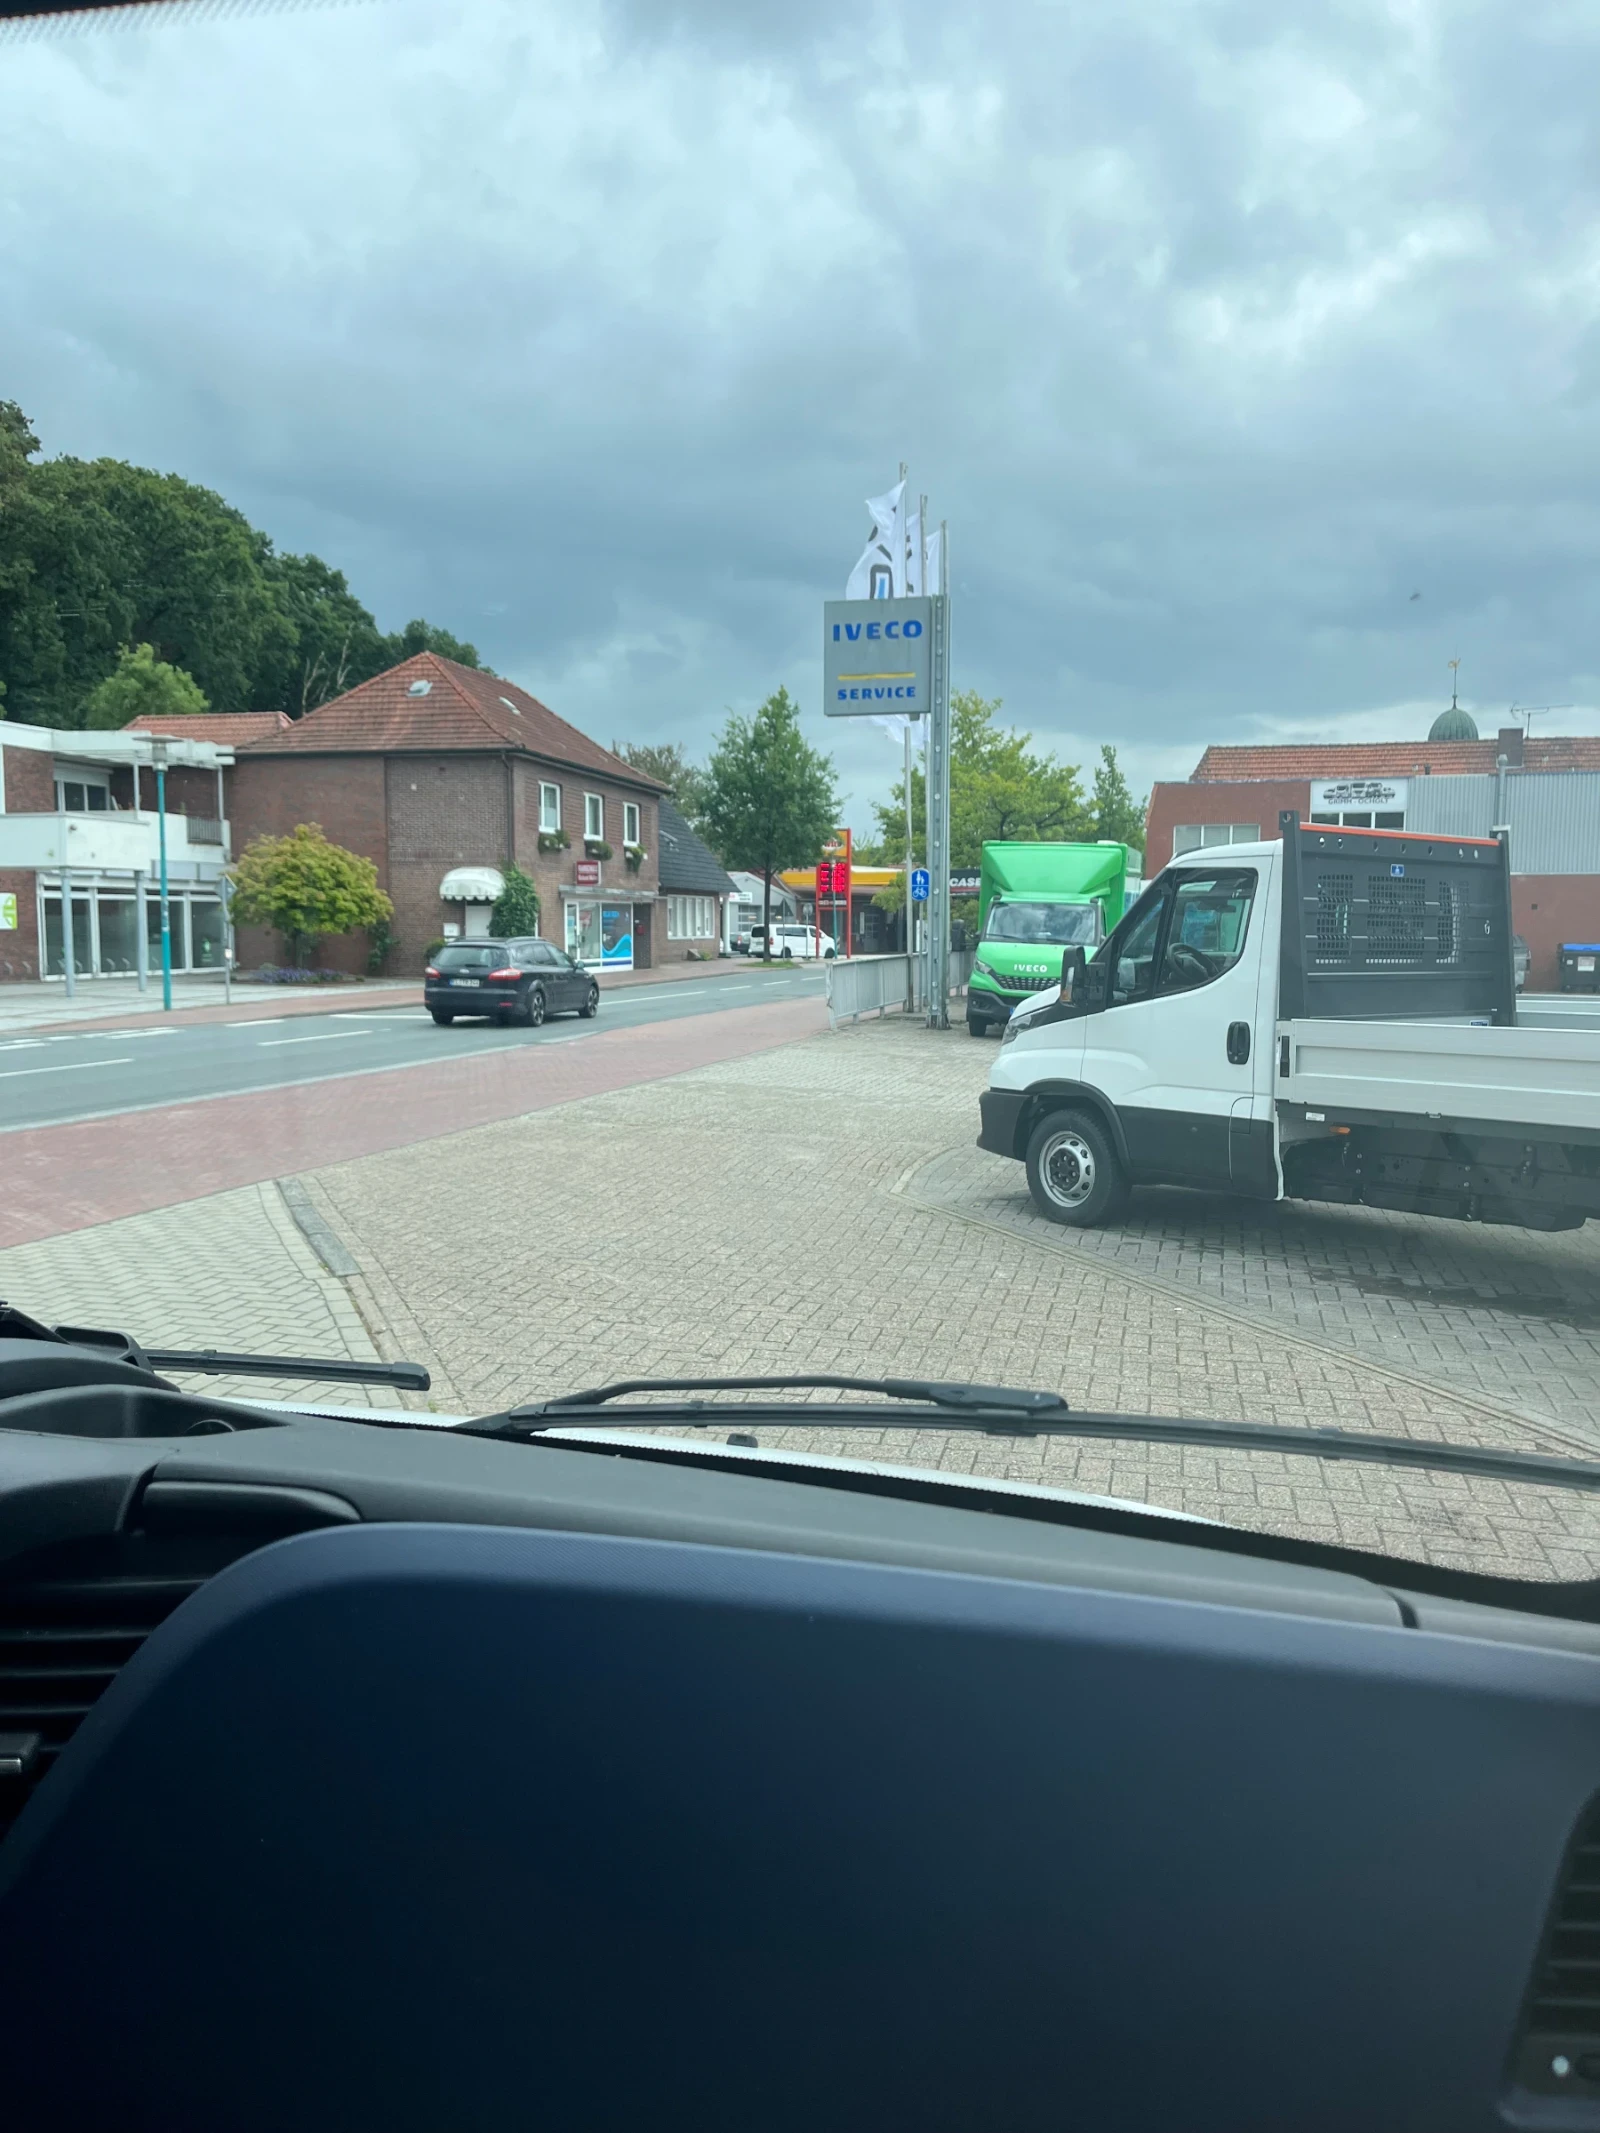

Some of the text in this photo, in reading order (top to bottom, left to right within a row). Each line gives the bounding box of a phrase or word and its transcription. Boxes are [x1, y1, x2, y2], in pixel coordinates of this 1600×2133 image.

[833, 620, 923, 642] IVECO
[837, 686, 916, 701] SERVICE
[1014, 964, 1048, 973] IVECO
